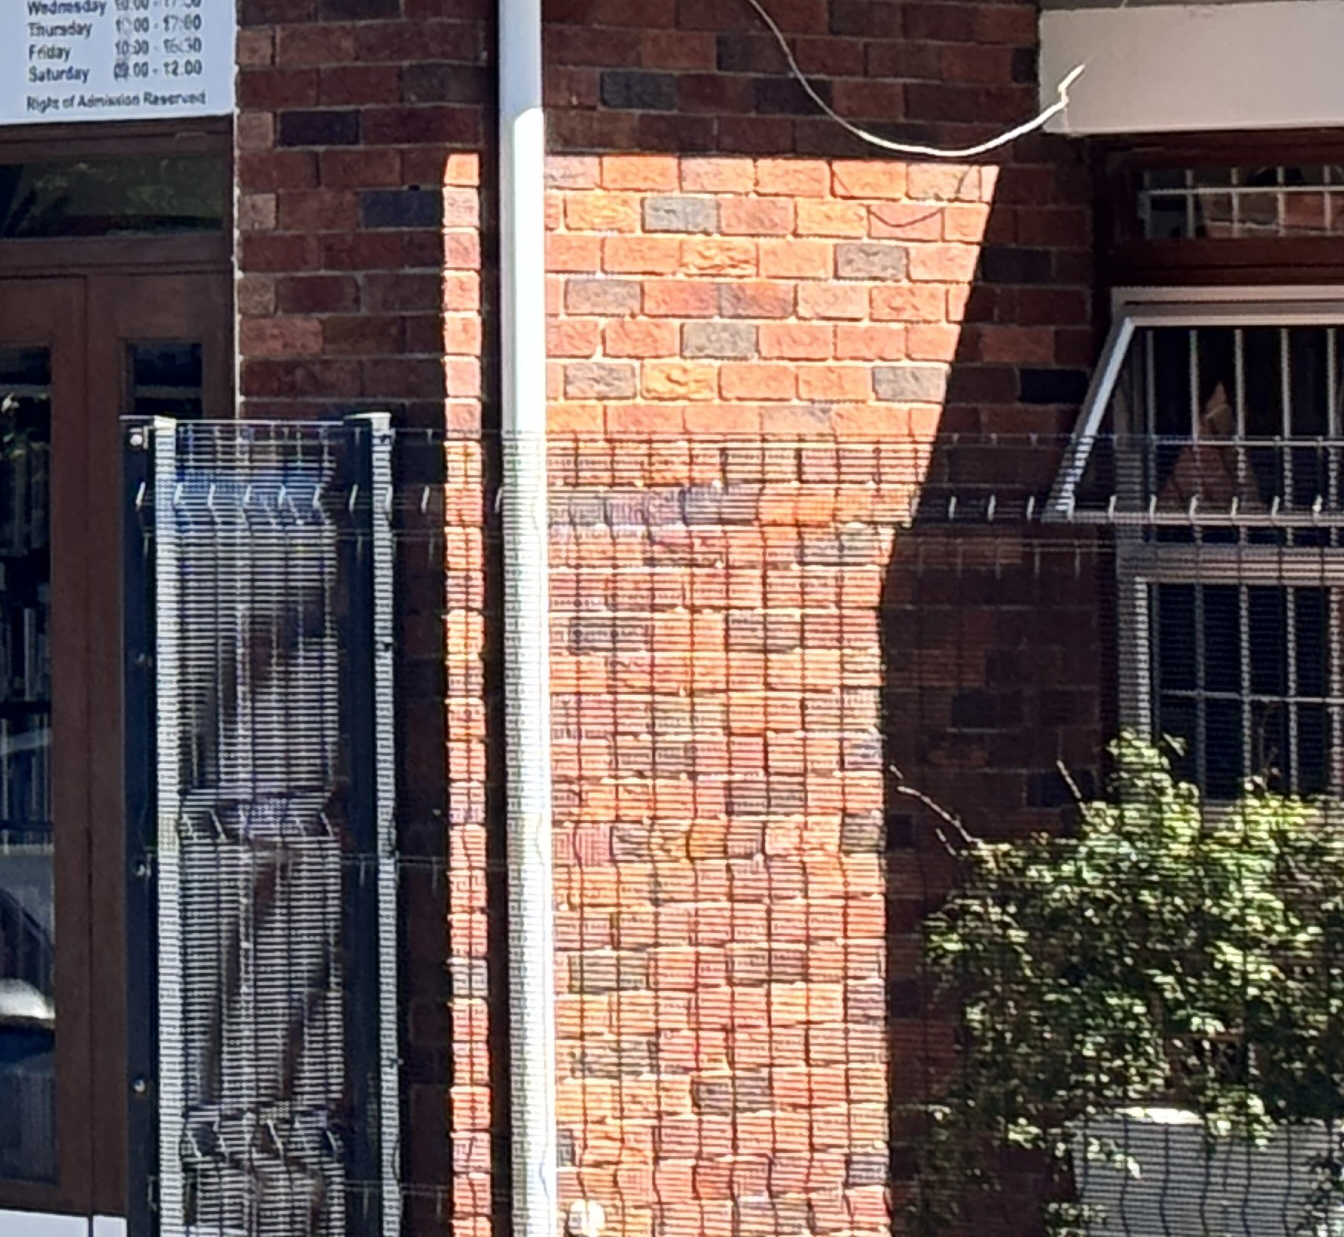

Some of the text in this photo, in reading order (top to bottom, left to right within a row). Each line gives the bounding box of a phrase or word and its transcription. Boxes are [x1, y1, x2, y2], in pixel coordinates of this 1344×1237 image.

[28, 20, 93, 40] Thursday
[28, 44, 72, 63] Friday
[28, 65, 90, 84] Saturday
[27, 90, 207, 114] Right of Admission Reserved
